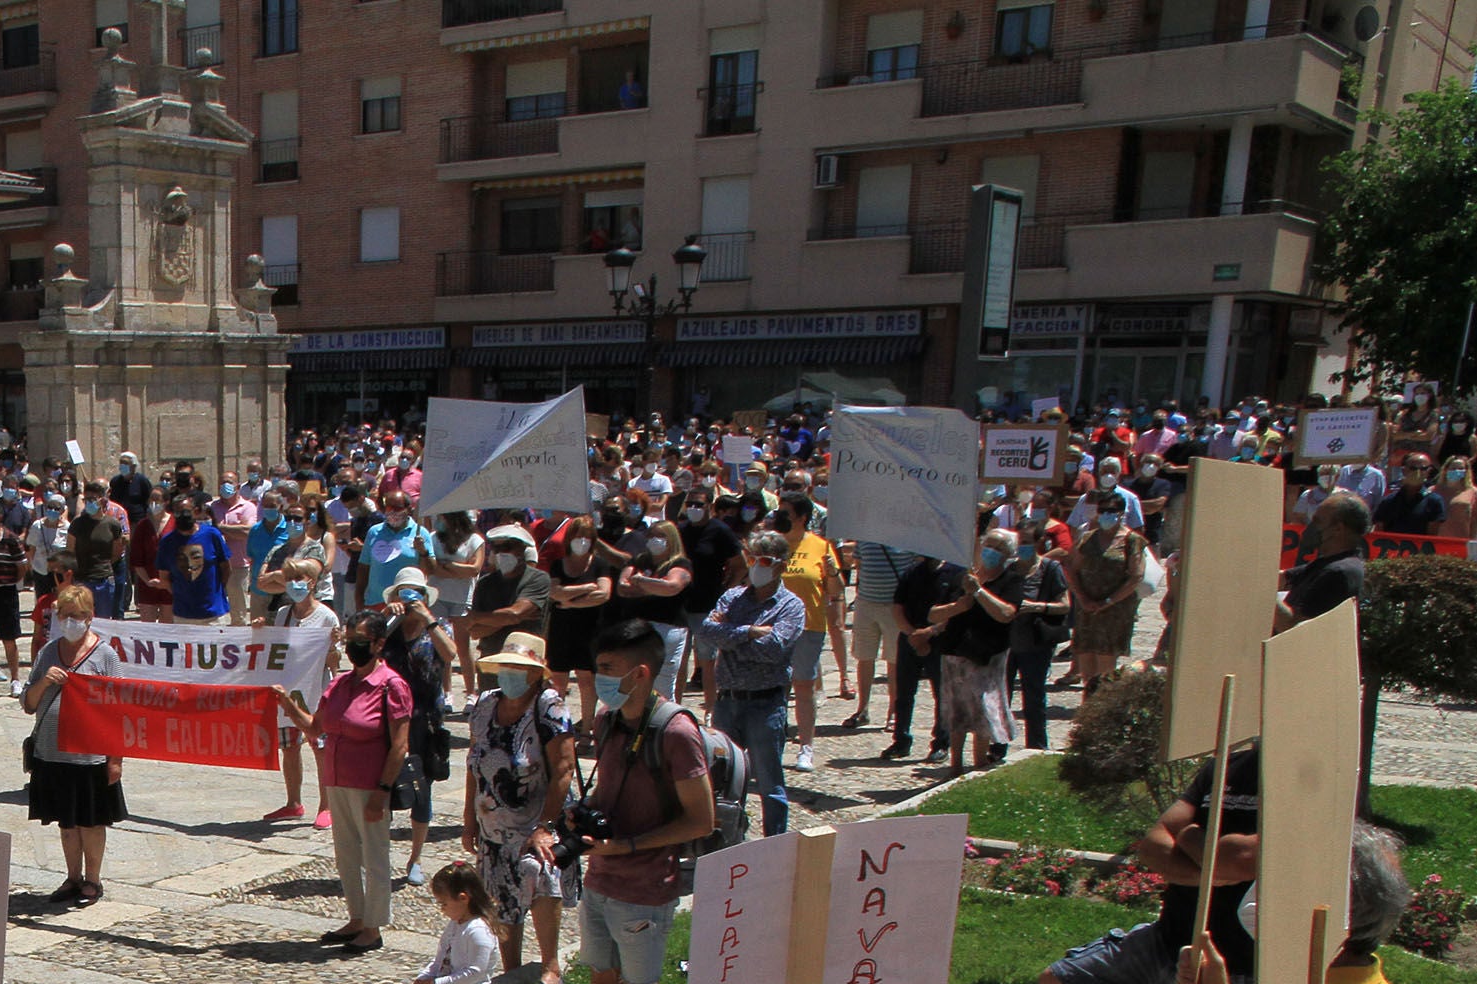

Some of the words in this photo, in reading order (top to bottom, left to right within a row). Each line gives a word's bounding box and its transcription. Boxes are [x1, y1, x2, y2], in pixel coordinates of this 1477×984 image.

[475, 327, 515, 344] MUEBLES
[522, 327, 534, 342] DE
[572, 322, 644, 340] SANEAMIENTOS
[681, 319, 757, 336] AZULEJOS
[767, 316, 865, 335] PAVIMENTOS
[876, 314, 917, 332] GRES
[307, 335, 322, 349] DE
[329, 334, 344, 348] LA
[500, 451, 557, 469] importa
[836, 449, 895, 475] Pocos
[999, 457, 1028, 467] CERO
[110, 636, 290, 671] ANTIUSTE
[87, 680, 180, 711] SANIDAD
[196, 688, 265, 715] RURAL
[123, 715, 148, 749] DE
[166, 717, 272, 757] CALIDAD
